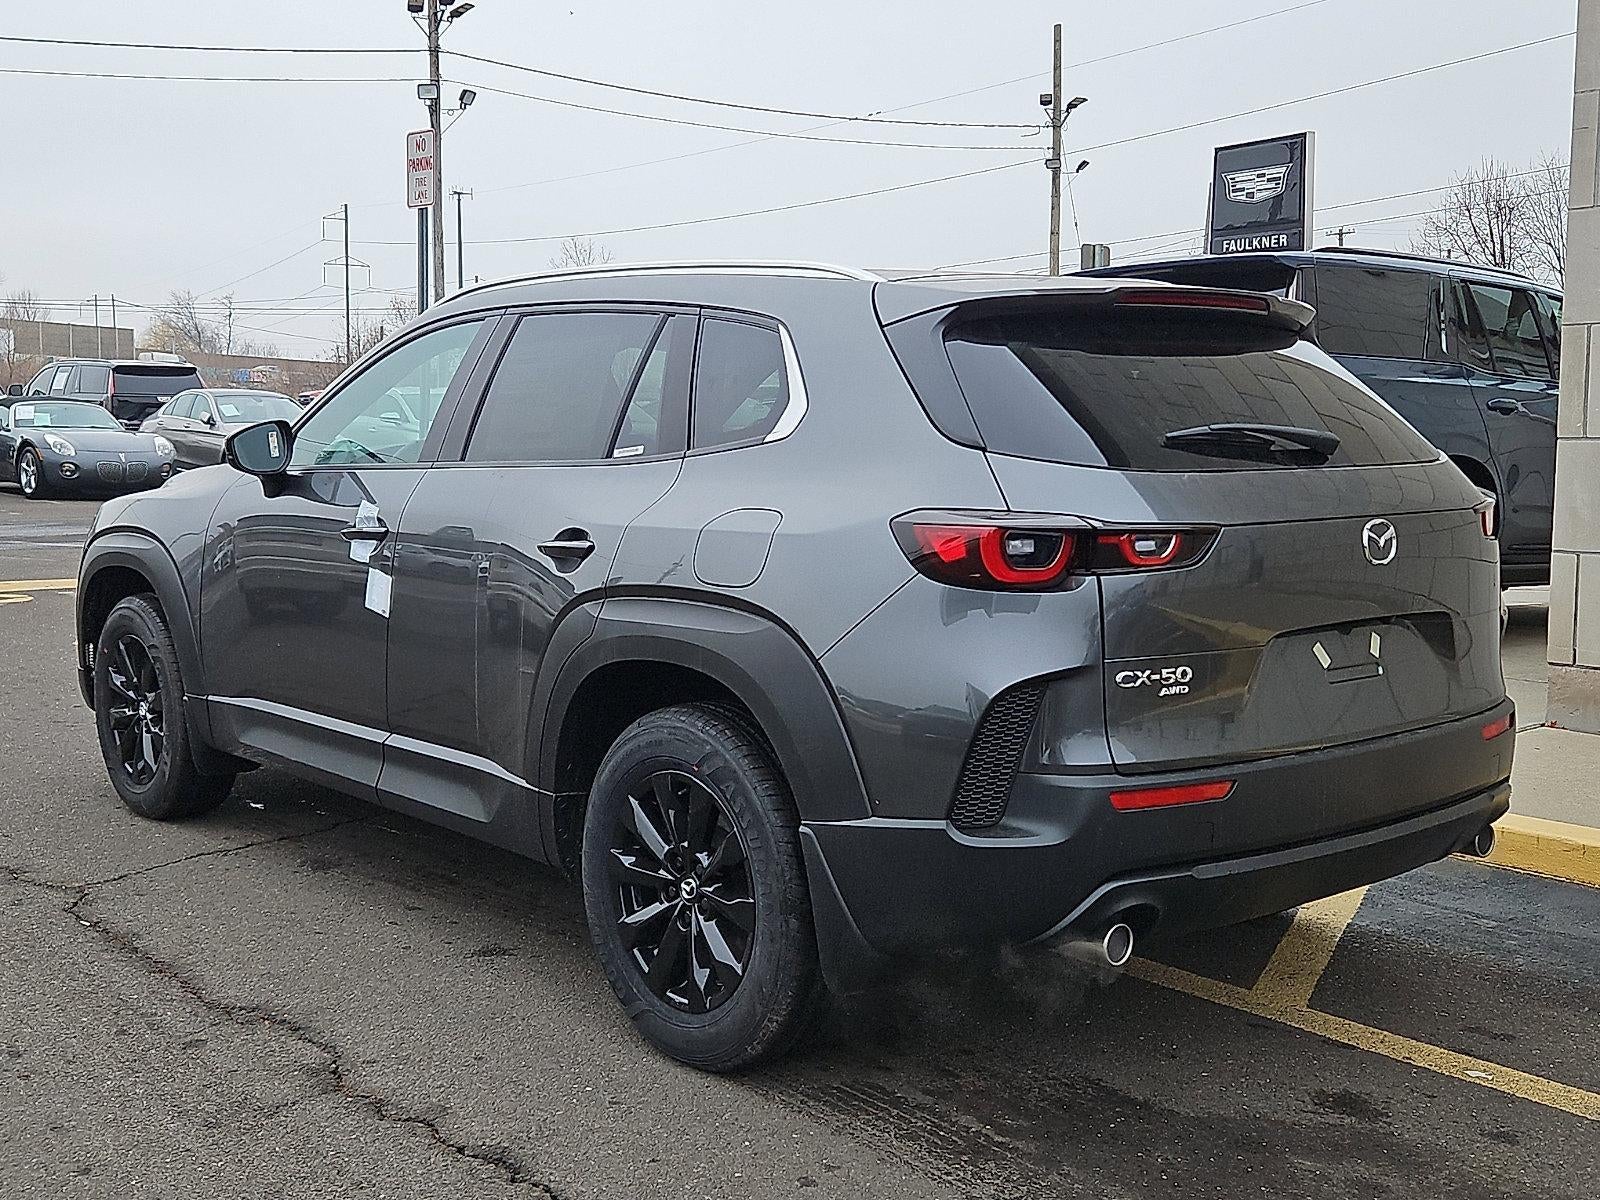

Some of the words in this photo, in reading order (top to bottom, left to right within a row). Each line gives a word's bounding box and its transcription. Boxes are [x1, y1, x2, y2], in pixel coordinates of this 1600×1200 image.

[415, 138, 426, 153] NO
[409, 157, 432, 174] PARKING
[415, 177, 427, 188] FIRE
[414, 190, 428, 201] LANE
[1222, 234, 1288, 253] FAULKNER
[1115, 666, 1193, 688] CX-50
[1158, 685, 1189, 697] AWD
